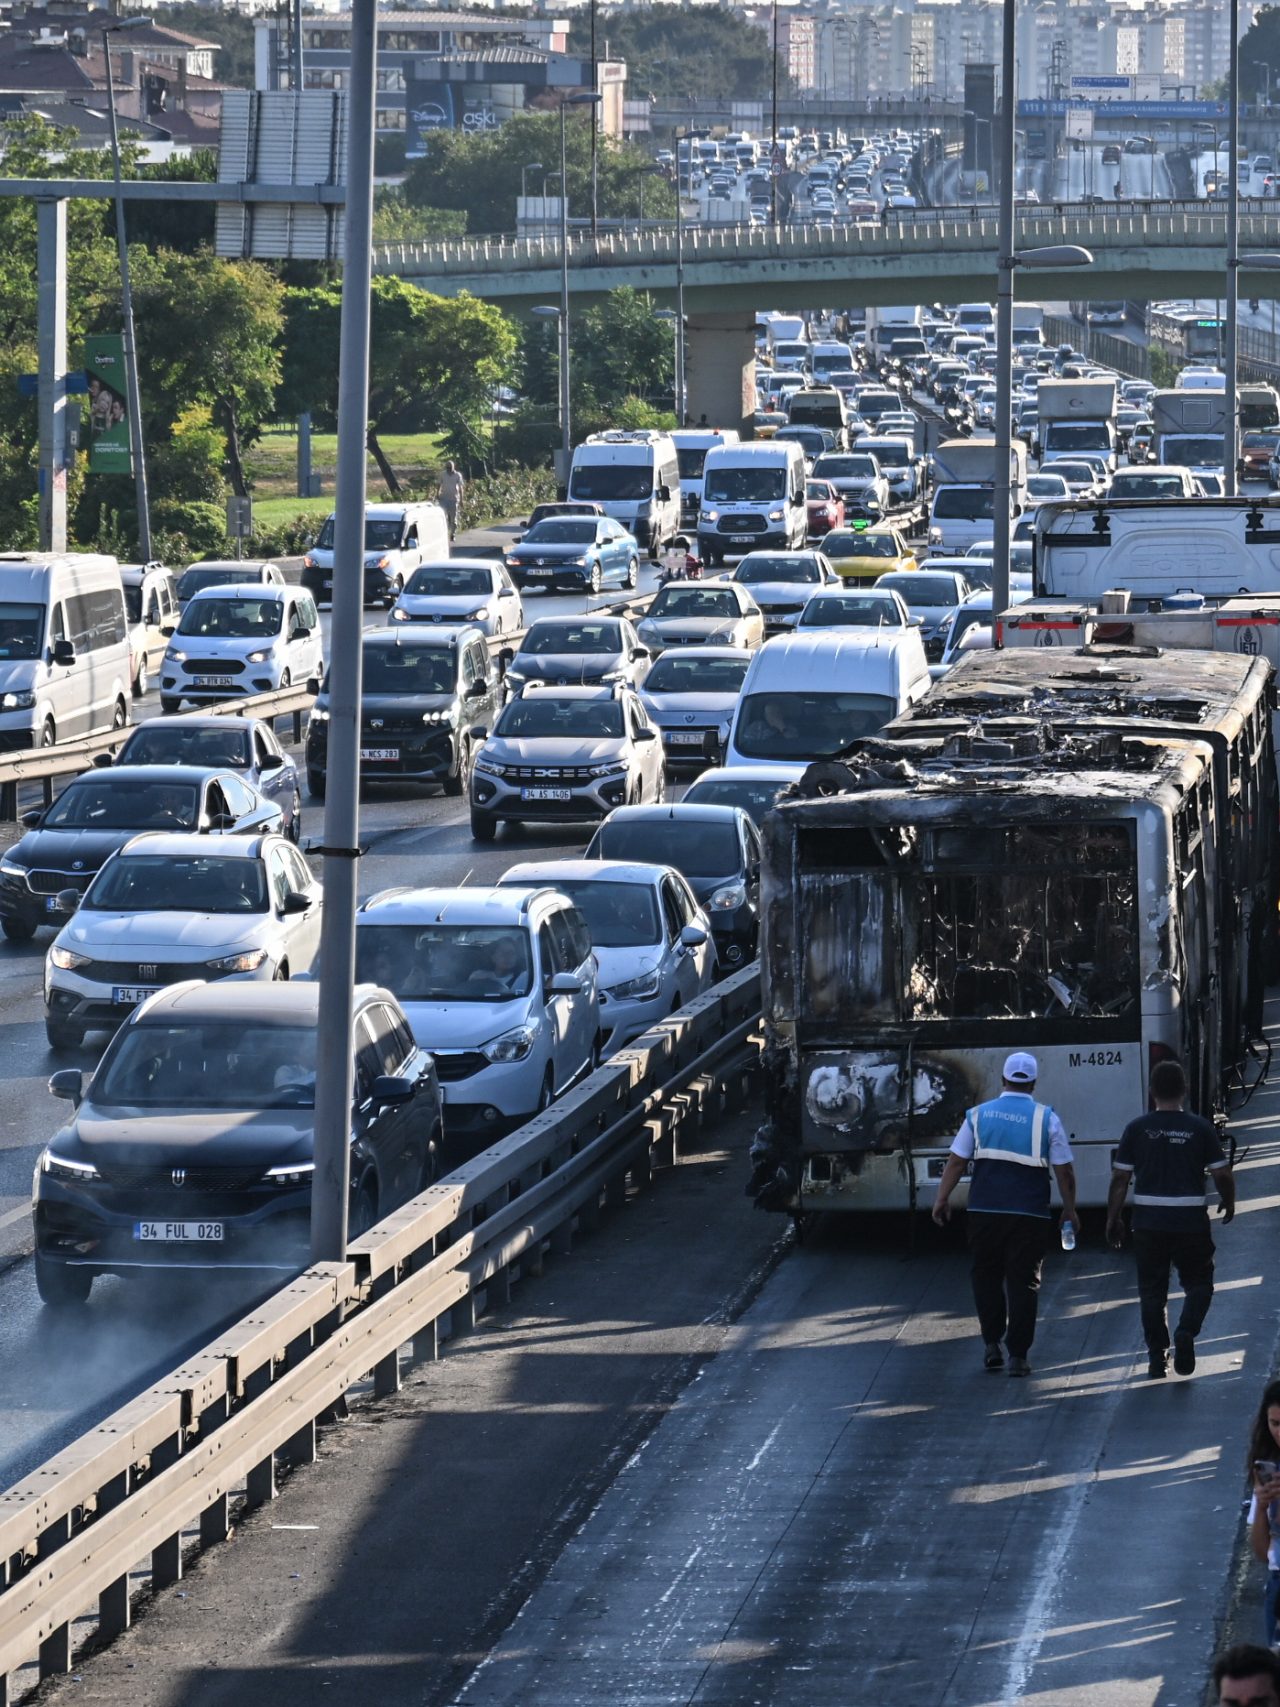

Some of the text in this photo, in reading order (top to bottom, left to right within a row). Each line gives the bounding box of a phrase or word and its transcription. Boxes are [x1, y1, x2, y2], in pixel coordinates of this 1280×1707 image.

[552, 790, 569, 798] 1406
[138, 964, 158, 980] FIAT
[119, 990, 131, 1001] 34
[1069, 1051, 1122, 1067] M-4824
[983, 1110, 1027, 1124] METROBÜS
[142, 1224, 222, 1238] 34 FUL 028
